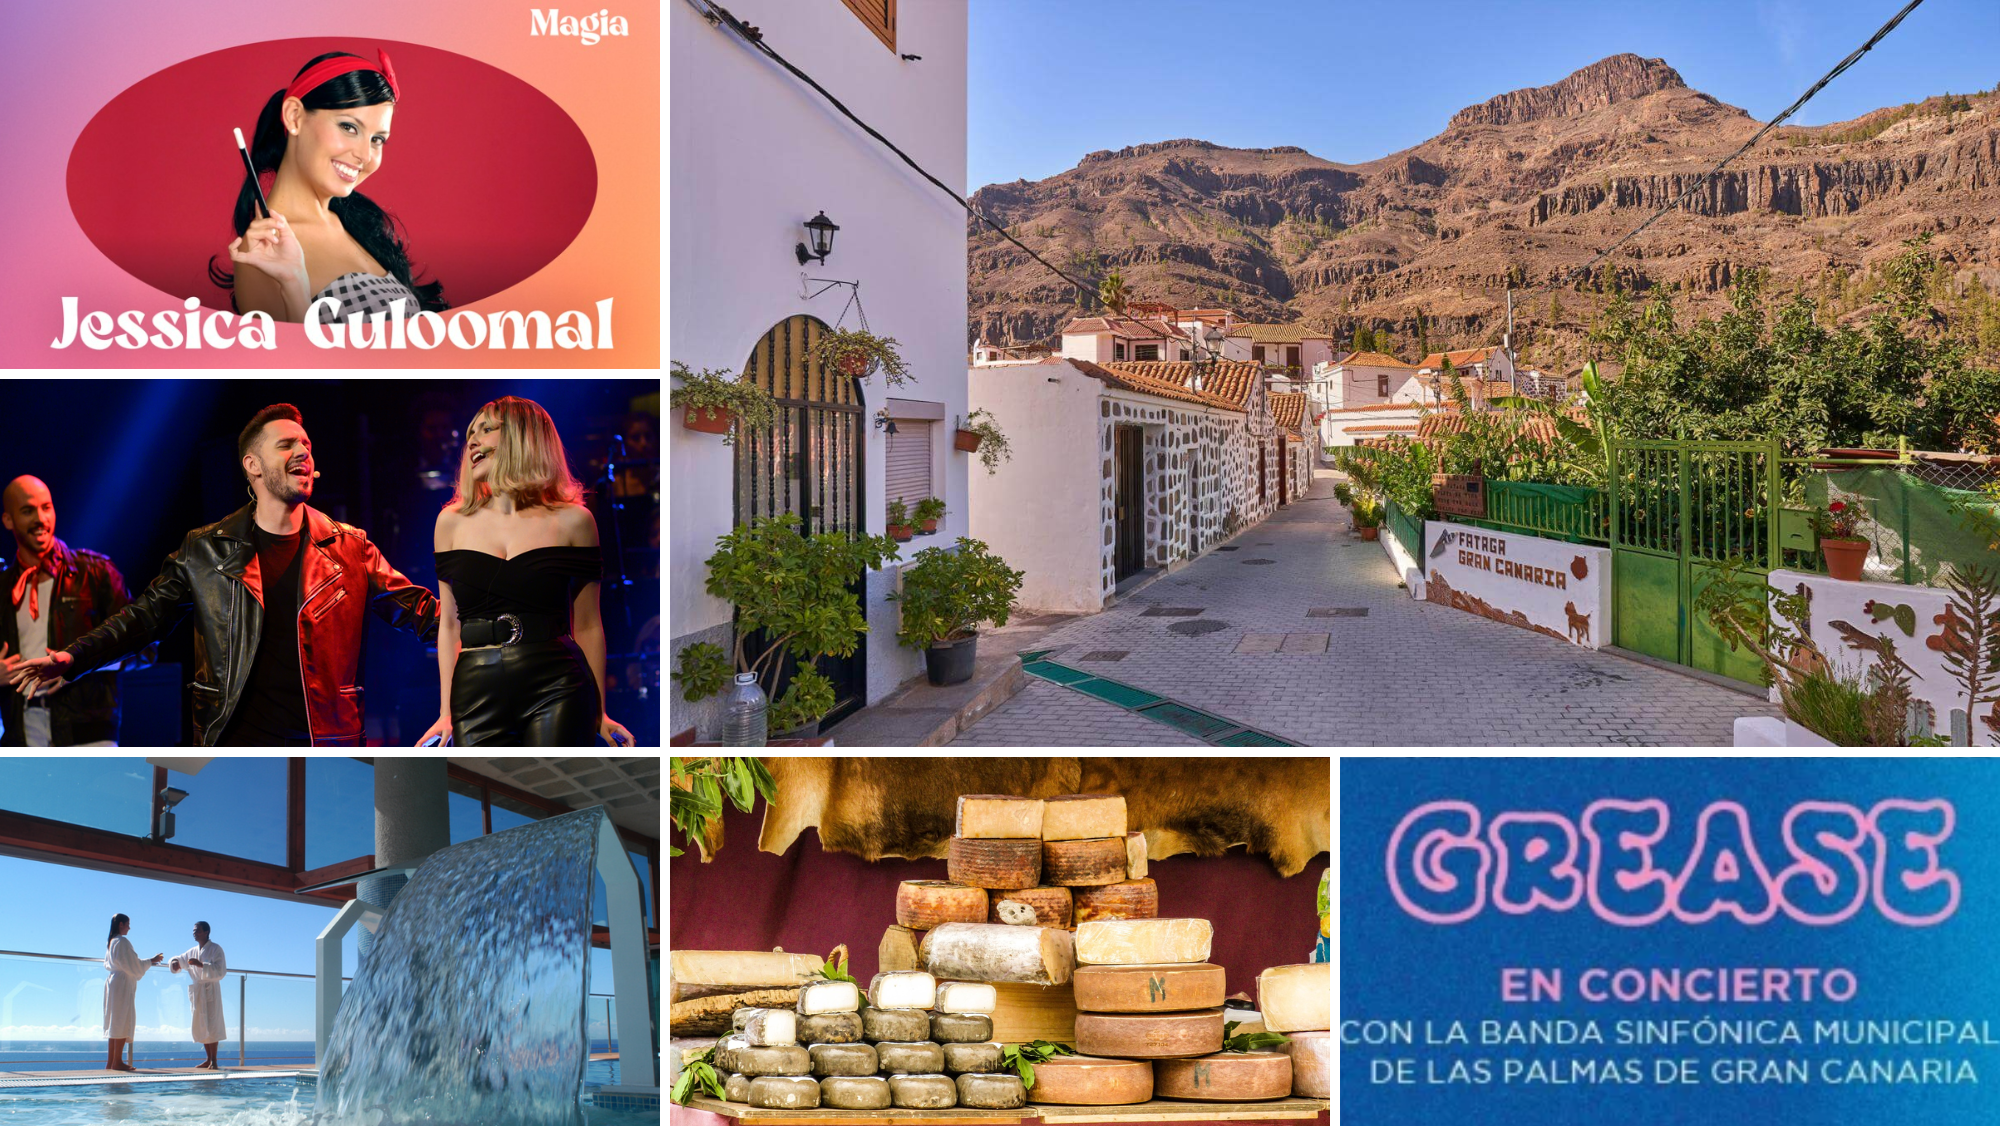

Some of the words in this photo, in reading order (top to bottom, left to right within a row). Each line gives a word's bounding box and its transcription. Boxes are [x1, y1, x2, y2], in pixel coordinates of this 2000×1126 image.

[1458, 532, 1506, 556] FATAGA
[1458, 549, 1491, 571] GRAN
[1495, 558, 1567, 590] CANARIA
[1386, 799, 1961, 926] GREASE
[1502, 968, 1562, 1001] EN
[1579, 968, 1857, 1001] CONCIERTO
[1340, 1020, 1412, 1044] CON
[1426, 1020, 1469, 1044] LA
[1481, 1020, 1604, 1044] BANDA
[1616, 1015, 1803, 1044] SINFÓNICA
[1815, 1020, 2000, 1044] MUNICIPAL
[1371, 1059, 1416, 1084] DE
[1428, 1059, 1492, 1084] LAS
[1504, 1059, 1644, 1084] PALMAS
[1655, 1059, 1700, 1084] DE
[1711, 1059, 1808, 1084] GRAN
[1821, 1059, 1979, 1084] CANARIA
